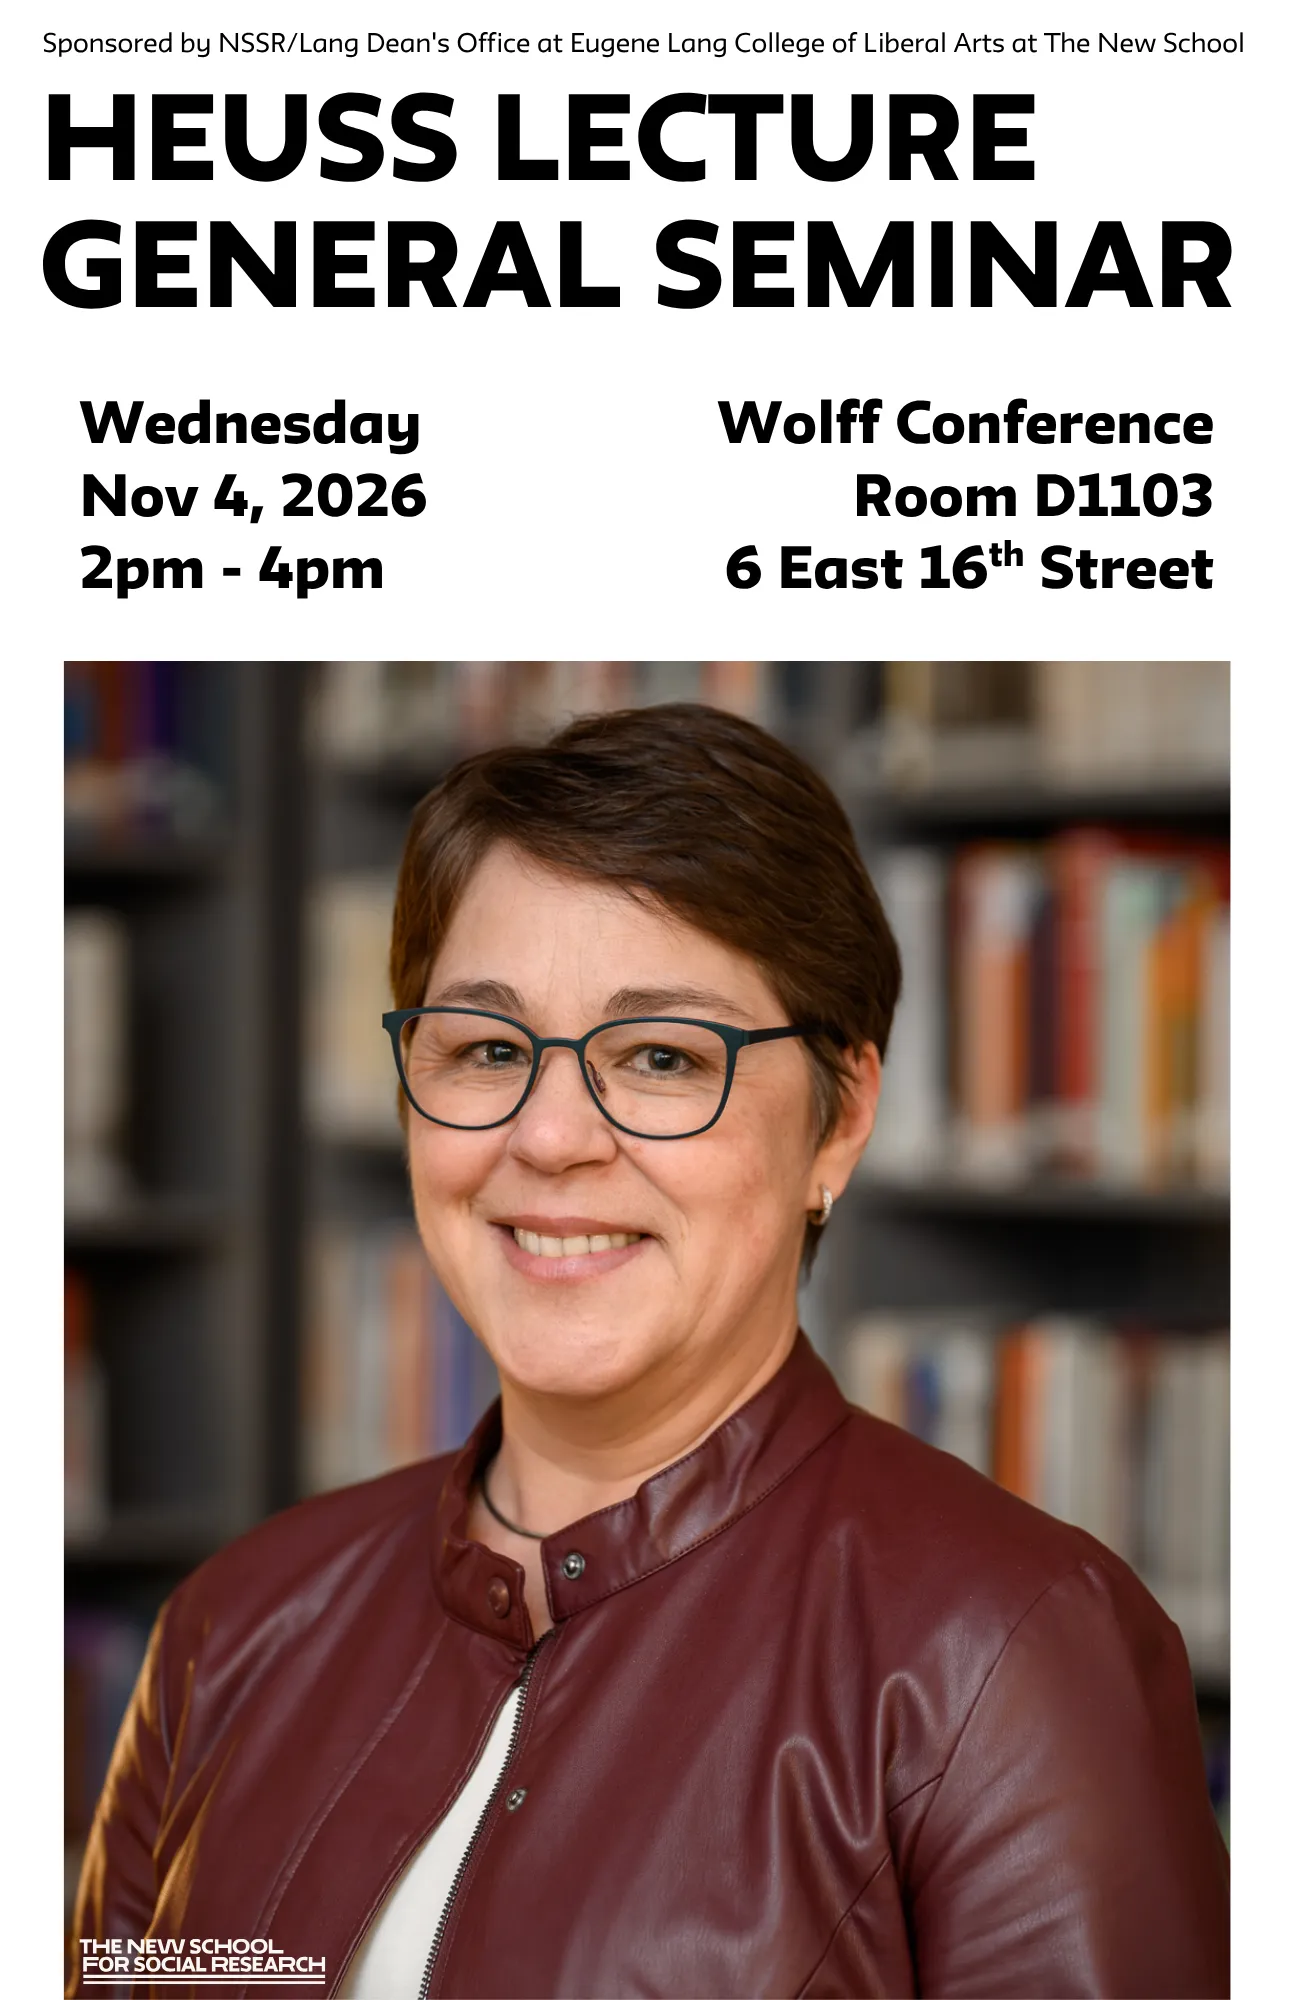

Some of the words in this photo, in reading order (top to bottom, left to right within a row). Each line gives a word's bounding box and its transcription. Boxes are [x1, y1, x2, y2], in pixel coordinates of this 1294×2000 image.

[43, 31, 173, 58] Sponsored
[182, 31, 210, 58] by
[219, 32, 358, 58] NSSR/Lang
[367, 31, 450, 54] Dean's
[457, 31, 530, 54] Office
[538, 34, 563, 54] at
[571, 32, 660, 58] Eugene
[668, 32, 727, 58] Lang
[734, 31, 825, 58] College
[832, 31, 858, 54] of
[864, 31, 946, 54] Liberal
[953, 32, 1005, 54] Arts
[1012, 34, 1038, 53] at
[1043, 31, 1090, 53] The
[1098, 32, 1157, 54] New
[1163, 31, 1244, 54] School
[48, 92, 458, 182] HEUSS
[497, 92, 1035, 182] LECTURE
[42, 218, 621, 310] GENERAL
[655, 218, 1233, 310] SEMINAR
[80, 398, 419, 455] Wednesday
[718, 397, 883, 445] Wolff
[896, 397, 1213, 445] Conference
[83, 473, 199, 518] Nov
[213, 473, 264, 524] 4,
[281, 472, 427, 518] 2026
[856, 473, 1017, 518] Room
[1036, 472, 1213, 518] D1103
[80, 544, 203, 600] 2pm
[222, 567, 241, 577] -
[258, 545, 383, 600] 4pm
[726, 544, 762, 590] 6
[780, 545, 904, 590] East
[920, 539, 1024, 590] 16th
[1040, 544, 1213, 590] Street
